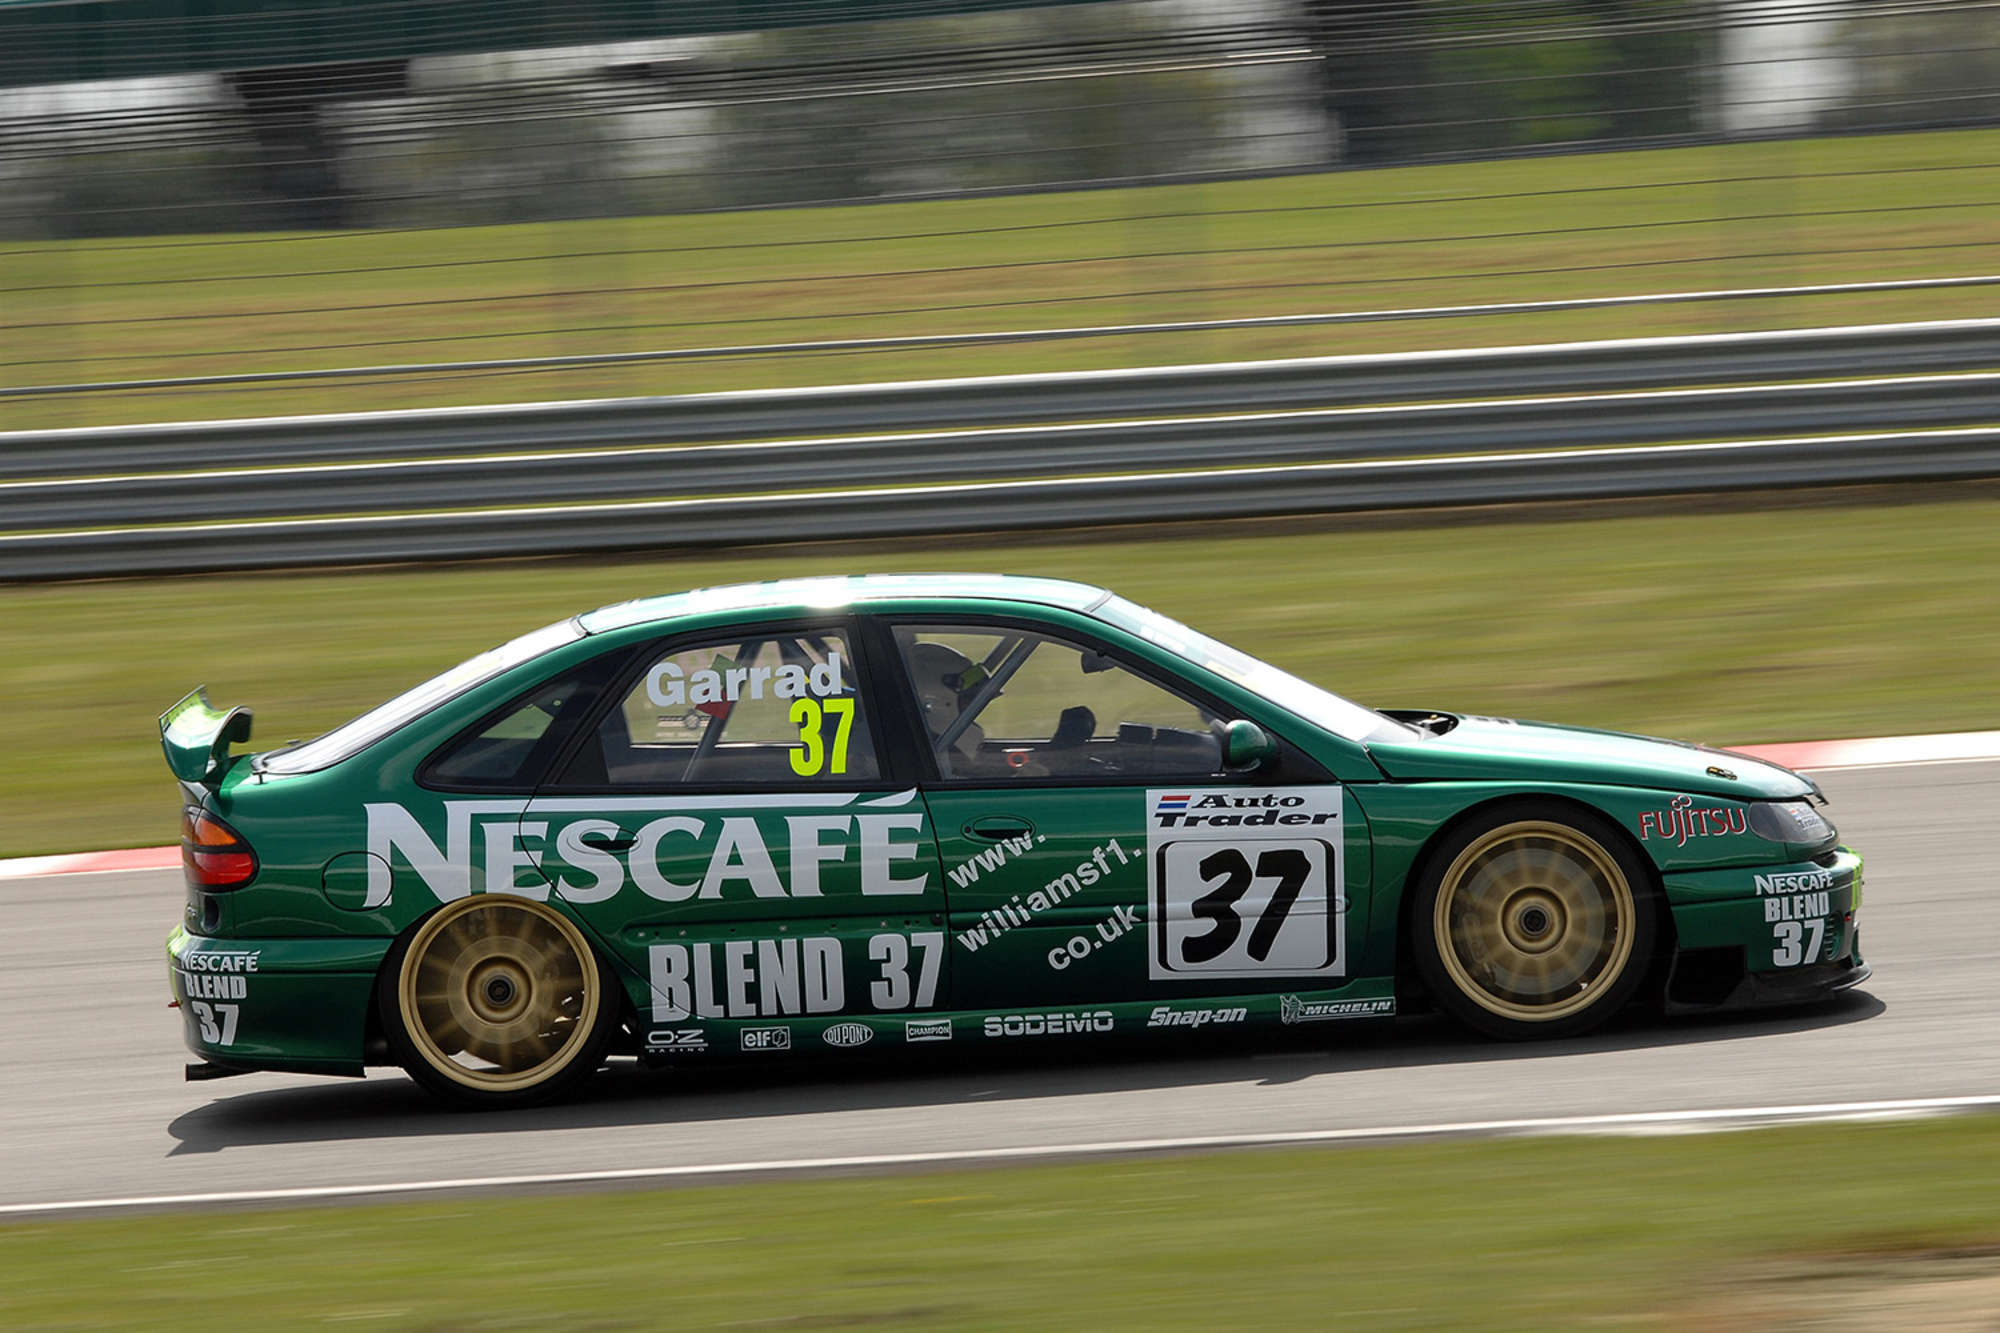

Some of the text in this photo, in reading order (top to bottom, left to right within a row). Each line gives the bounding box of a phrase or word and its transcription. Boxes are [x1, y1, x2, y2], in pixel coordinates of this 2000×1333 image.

[646, 652, 842, 707] Garrad
[789, 698, 855, 776] 37
[1154, 810, 1338, 828] Trader
[1192, 794, 1305, 809] Auto
[1638, 801, 1746, 848] FUJITSU
[363, 786, 929, 907] NESCAFÉ
[948, 830, 1046, 888] www.
[957, 838, 1142, 954] williamsf1.
[1181, 848, 1312, 963] 37
[1764, 891, 1830, 922] BLEND
[1047, 904, 1142, 970] co.uk
[1773, 918, 1825, 967] 37
[184, 971, 247, 999] BLEND
[649, 932, 945, 1023] BLEND 37
[191, 1001, 240, 1046] 37
[908, 1025, 950, 1037] CHAMPION
[984, 1010, 1115, 1038] SODEMO
[1147, 1005, 1248, 1030] Snap-on
[1304, 1000, 1393, 1017] MICHELIN
[744, 1031, 771, 1047] elf
